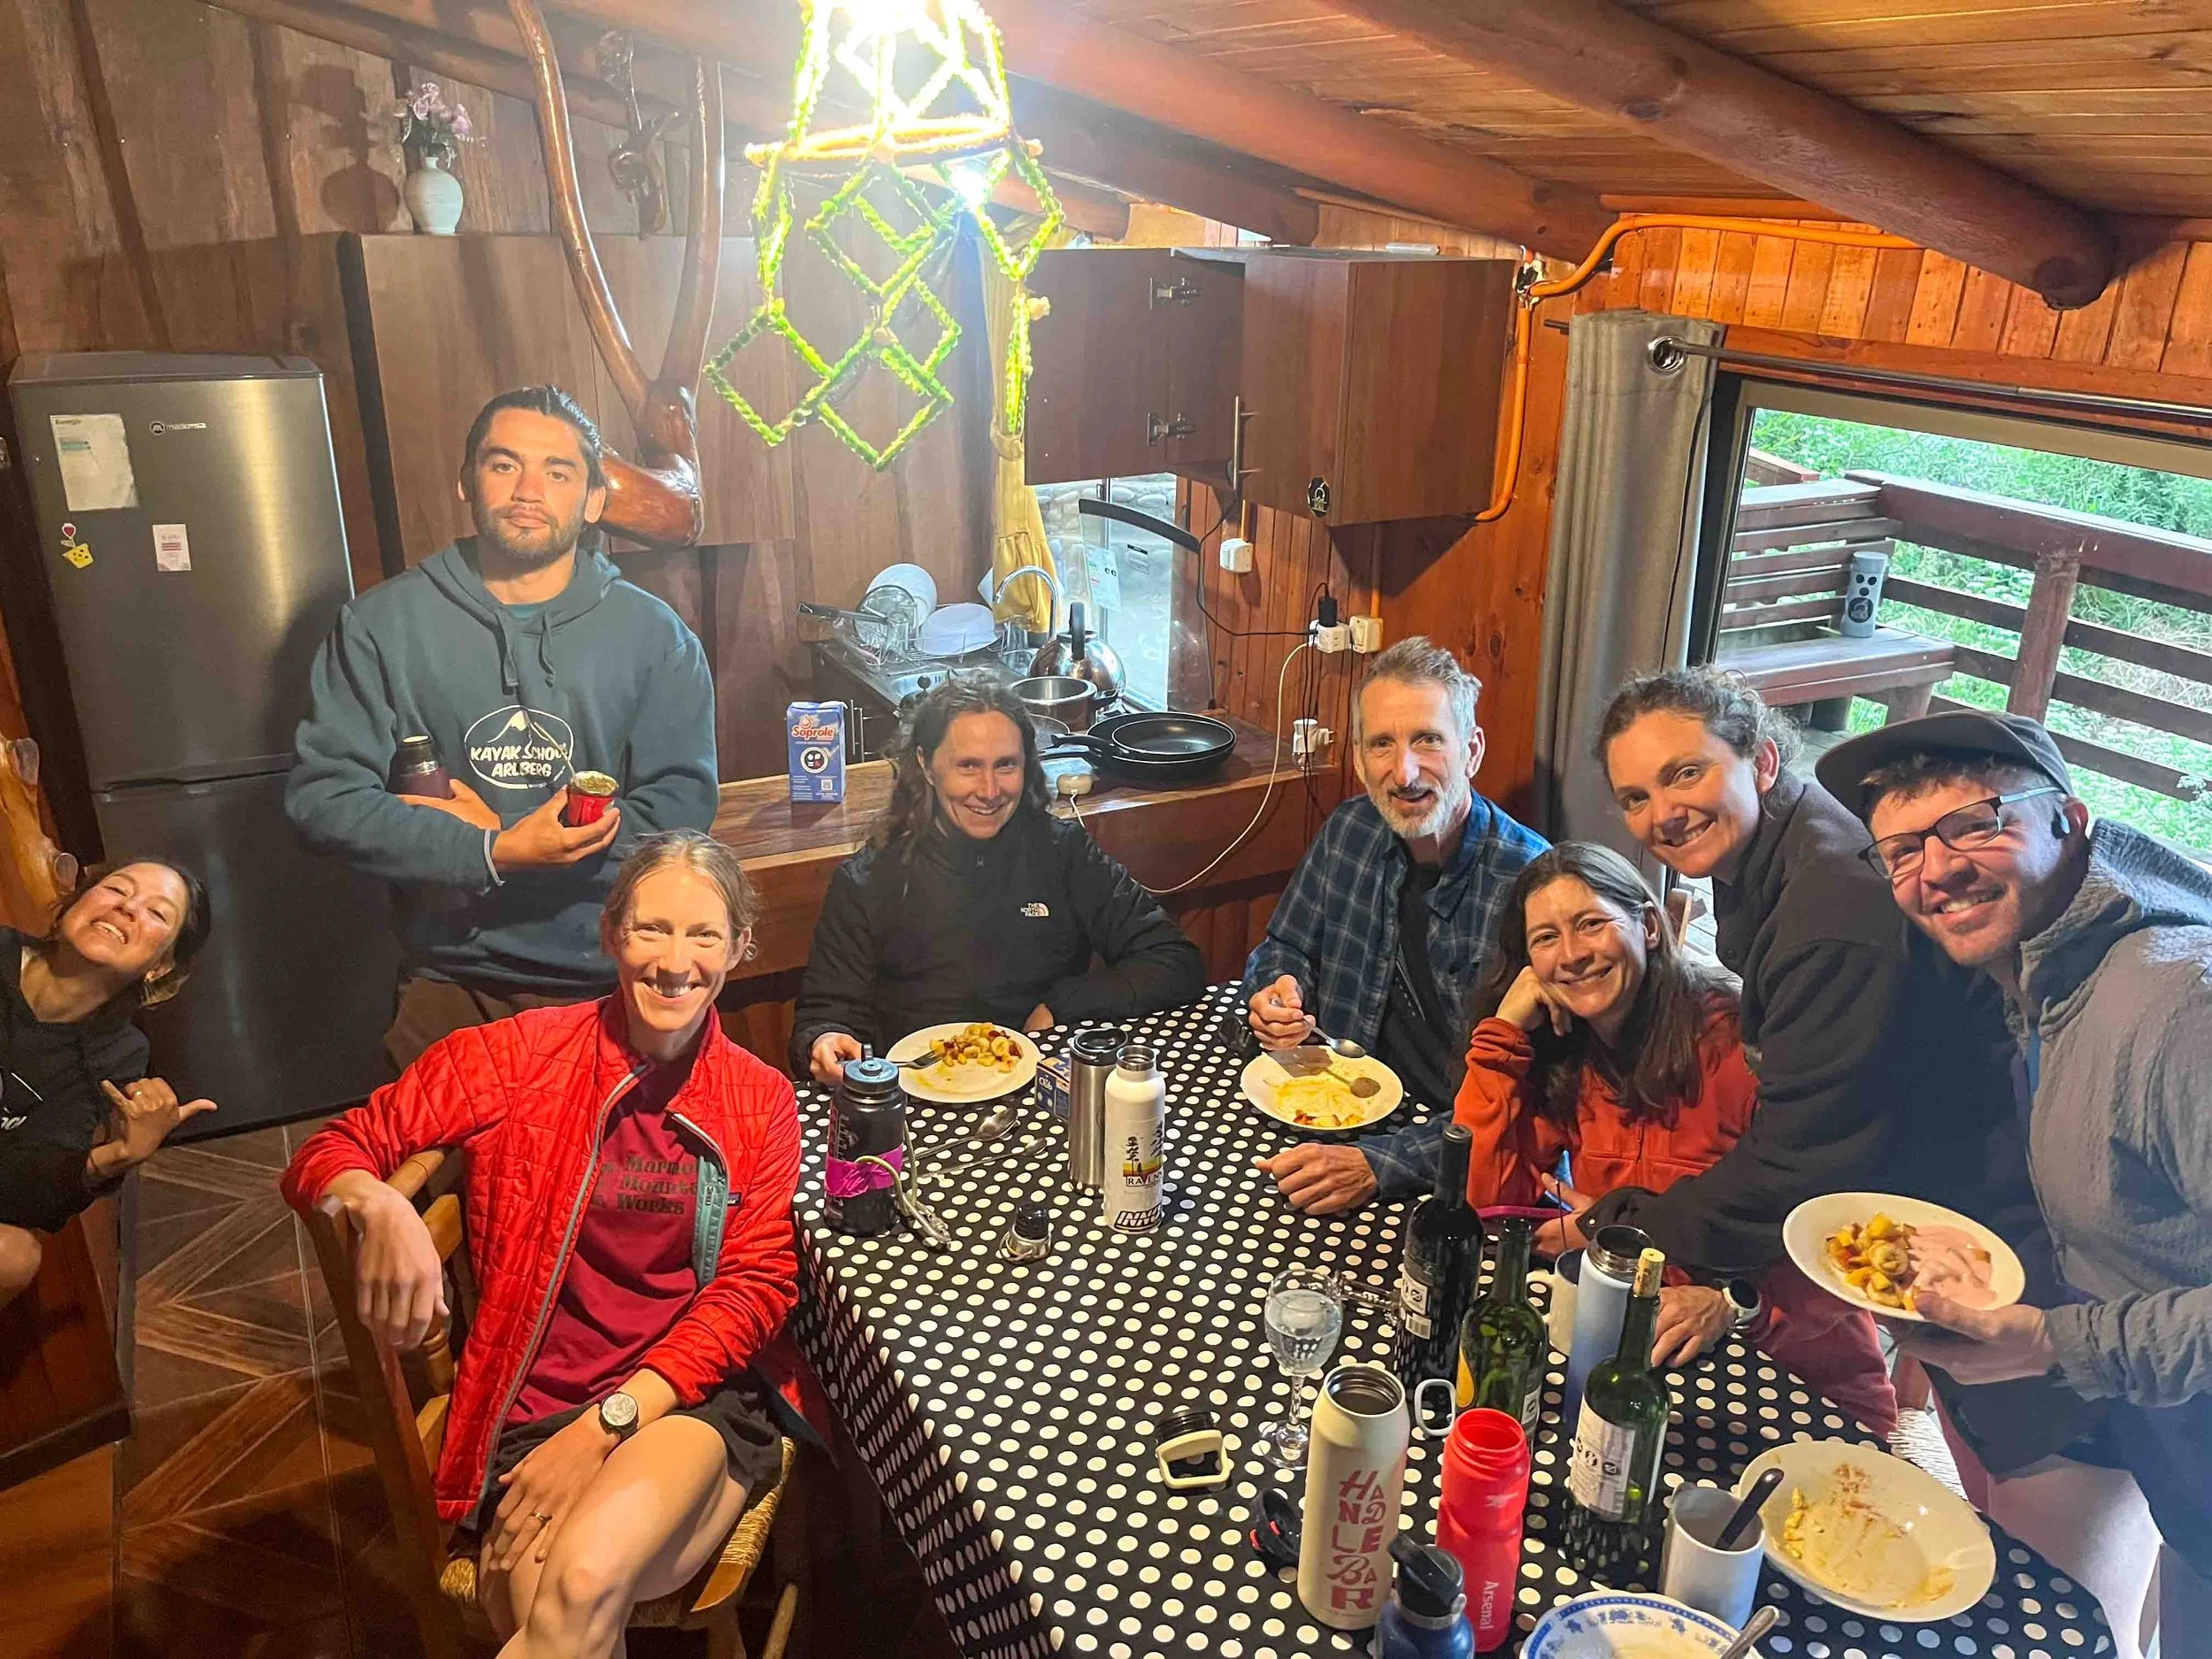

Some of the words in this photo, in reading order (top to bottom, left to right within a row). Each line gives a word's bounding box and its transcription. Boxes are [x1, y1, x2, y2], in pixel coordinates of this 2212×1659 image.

[792, 726, 834, 740] Soprole
[471, 746, 521, 761] KAYAK
[491, 762, 552, 777] ARLBERG
[1479, 1580, 1500, 1629] Arsenal
